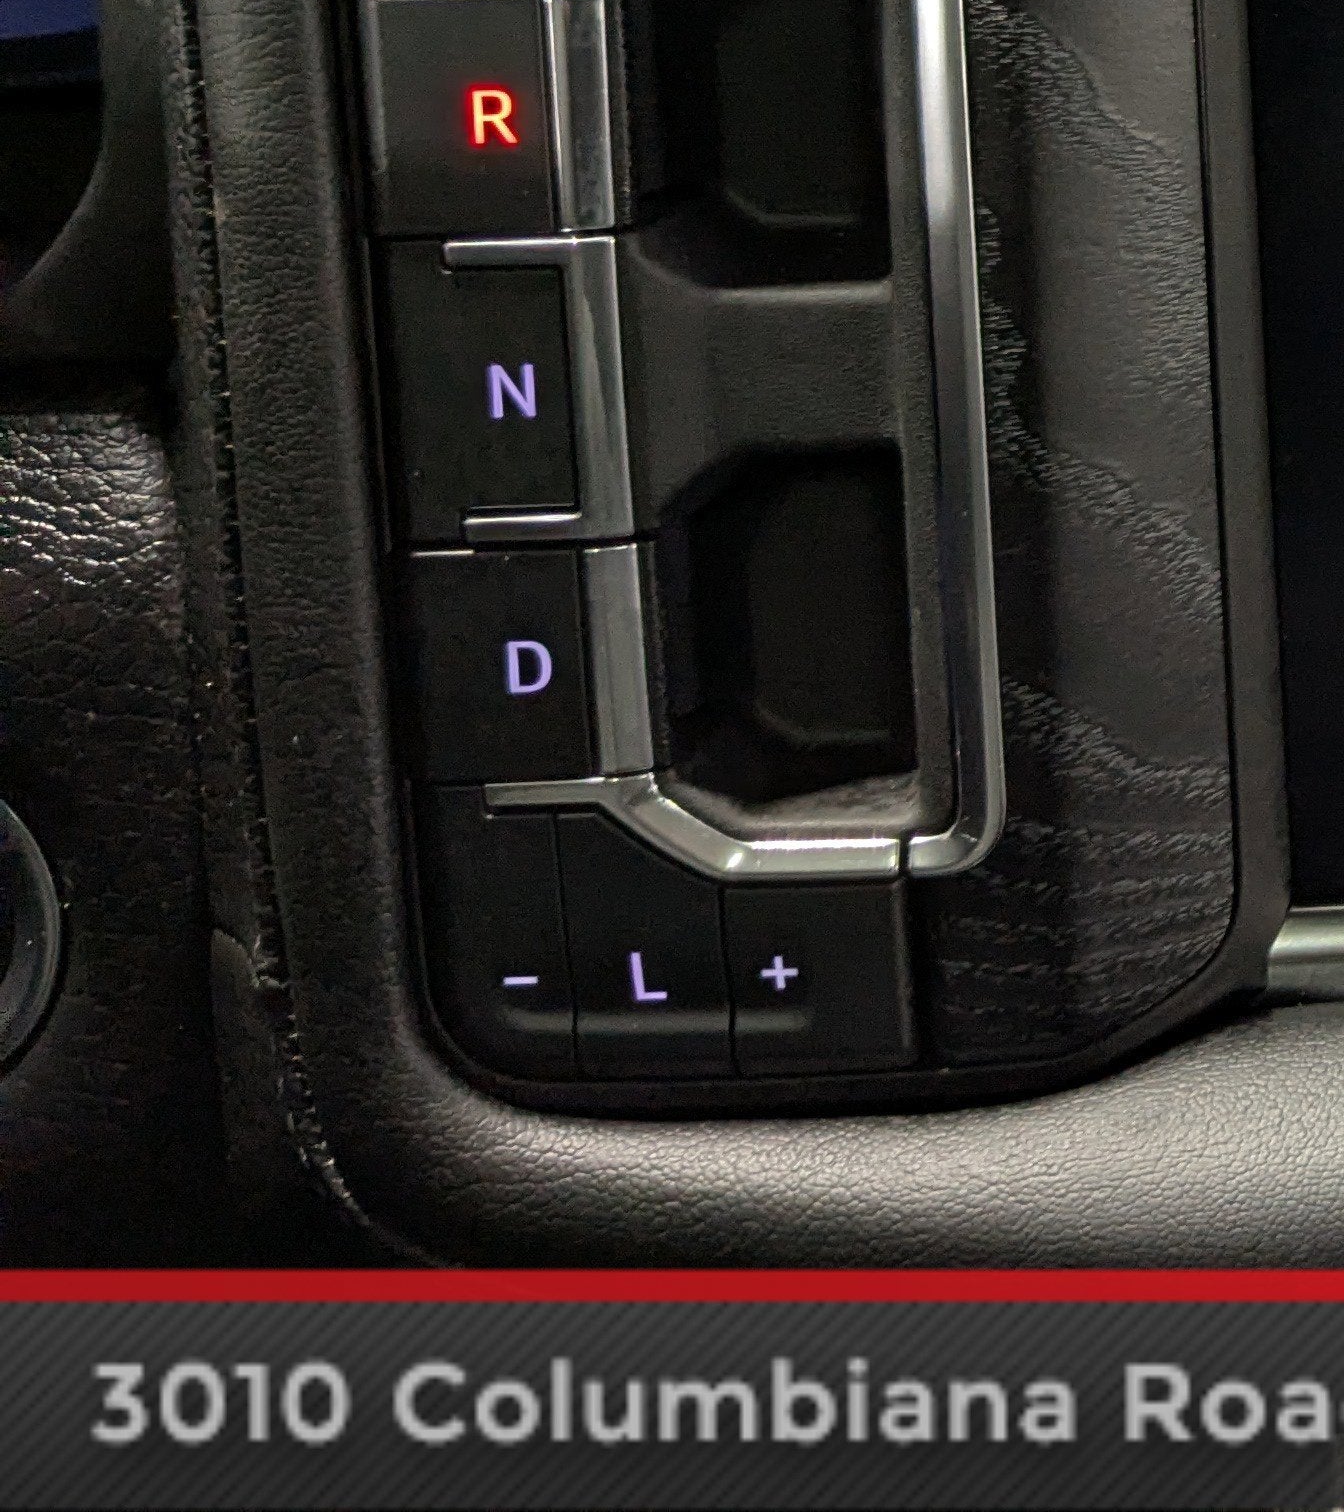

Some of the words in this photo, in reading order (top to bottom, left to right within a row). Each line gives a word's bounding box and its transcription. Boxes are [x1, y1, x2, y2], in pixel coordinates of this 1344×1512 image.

[469, 86, 519, 147] R
[486, 363, 538, 420] N
[505, 639, 554, 695] D
[629, 951, 669, 1002] L
